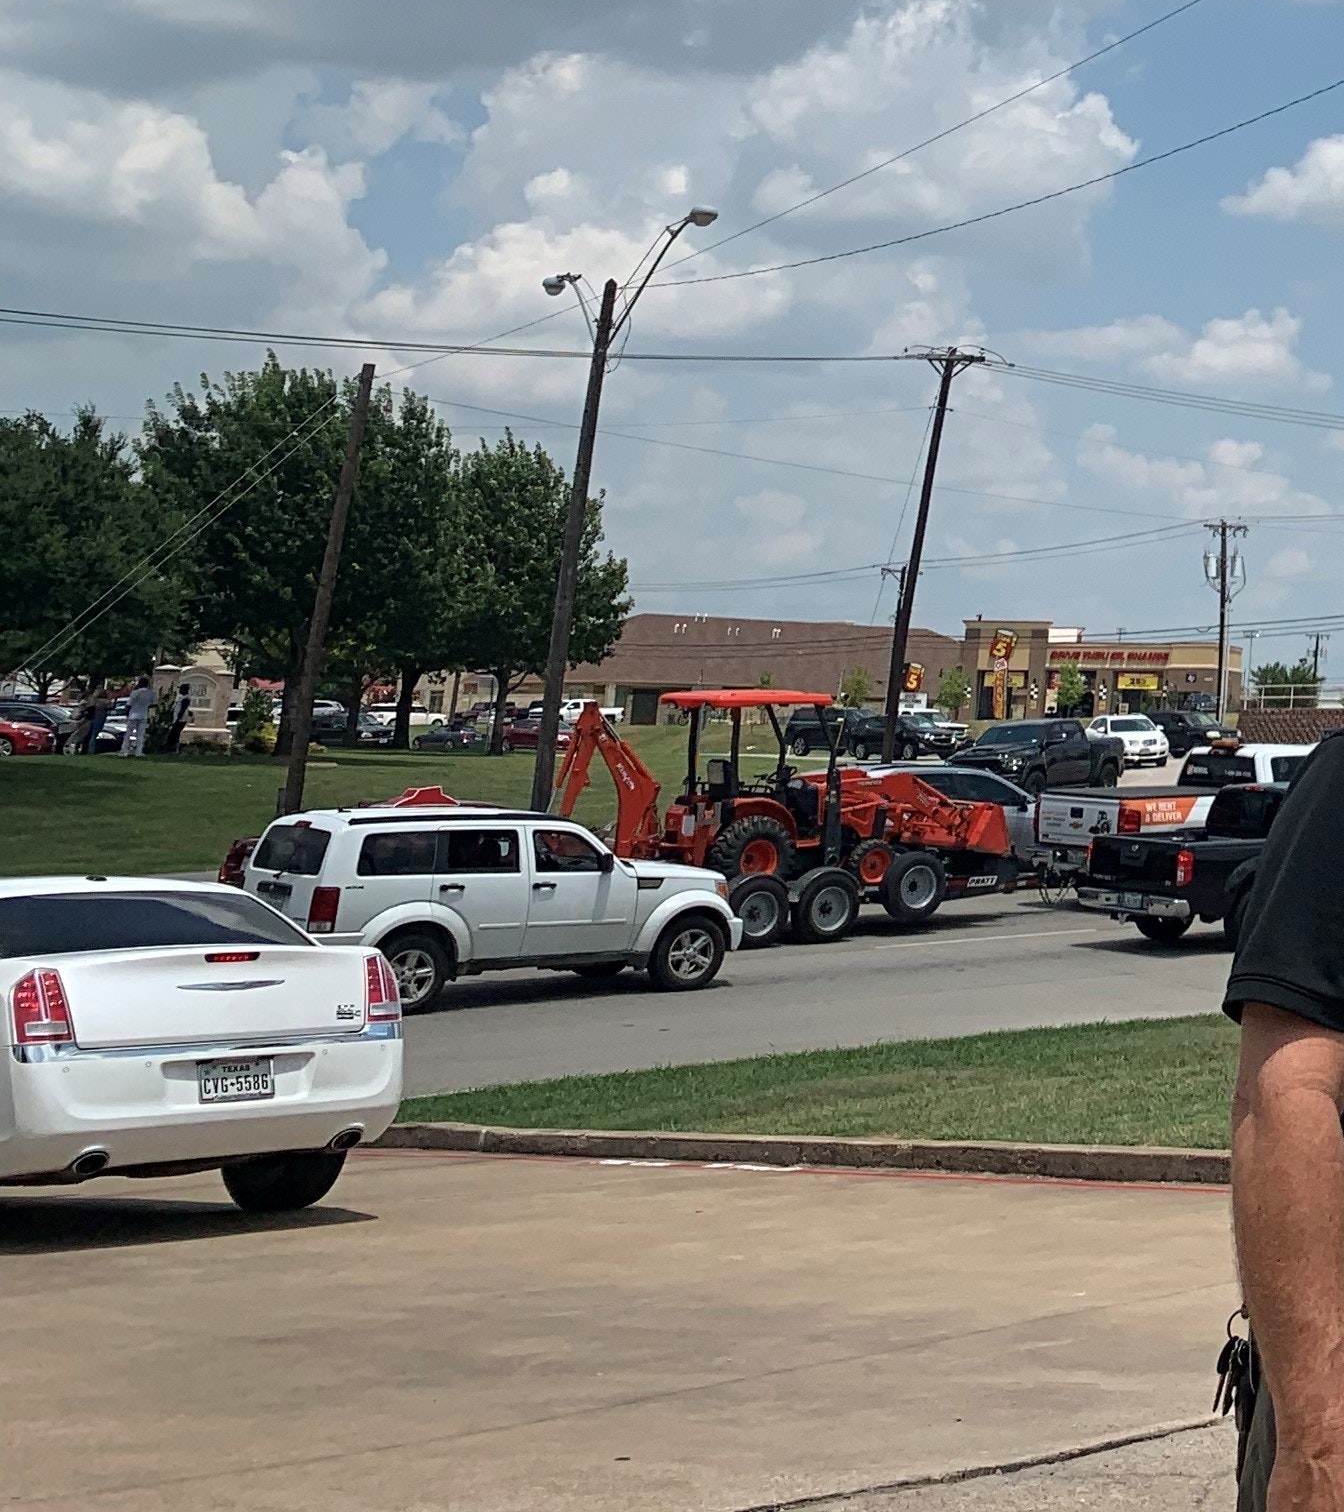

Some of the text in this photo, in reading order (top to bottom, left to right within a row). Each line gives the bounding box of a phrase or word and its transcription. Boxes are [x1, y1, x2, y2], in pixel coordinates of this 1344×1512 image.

[906, 674, 918, 689] 5
[1144, 801, 1160, 813] WE
[1151, 811, 1183, 823] DELIVER
[968, 876, 996, 886] PRATT
[222, 1064, 251, 1073] TEXAS
